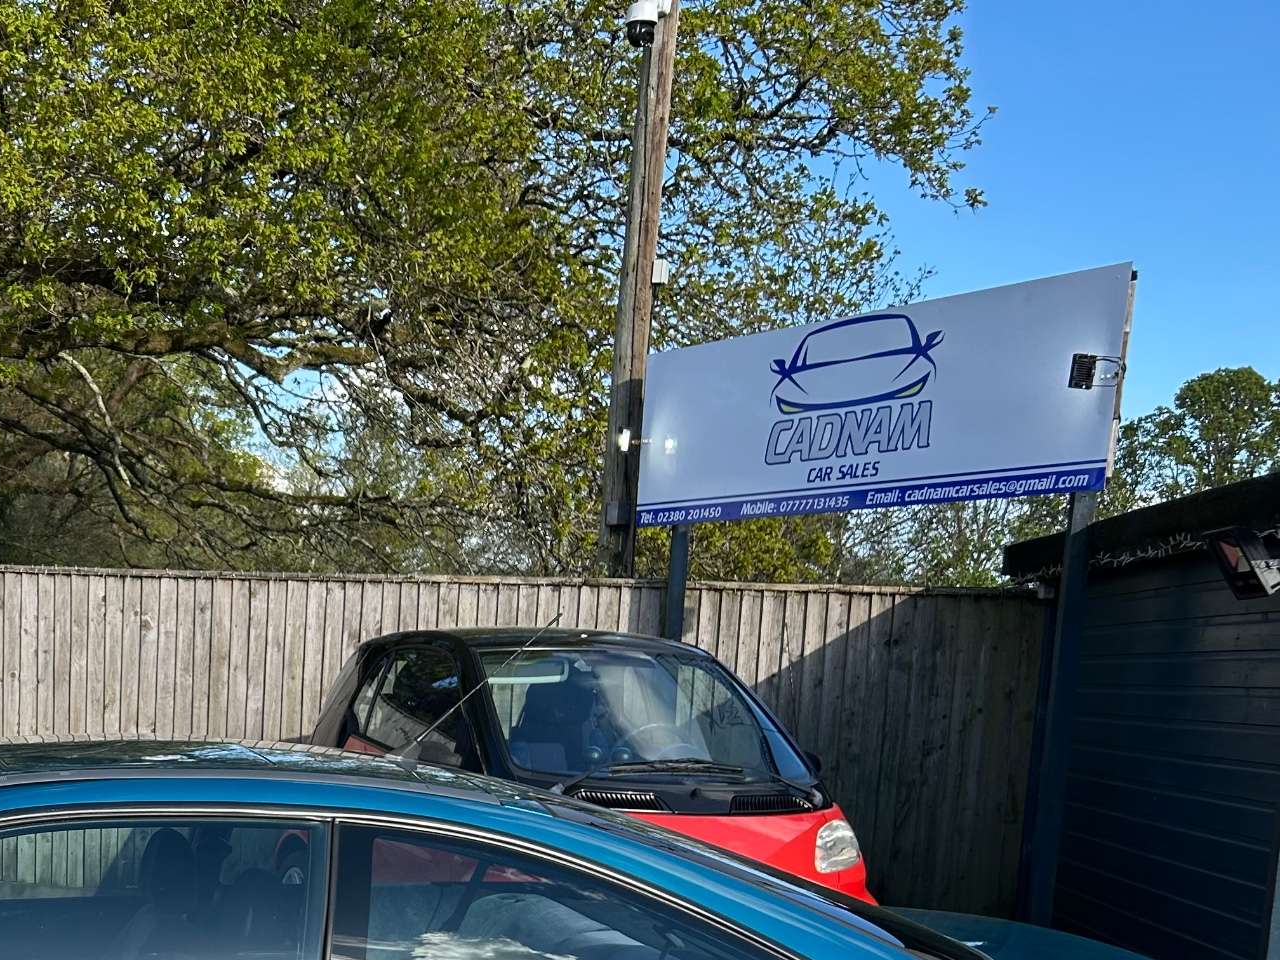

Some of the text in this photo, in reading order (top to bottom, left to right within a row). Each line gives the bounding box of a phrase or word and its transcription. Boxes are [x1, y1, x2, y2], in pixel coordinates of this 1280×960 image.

[765, 400, 933, 465] CADNAM
[807, 461, 881, 483] CAR SALES
[640, 473, 1090, 524] Tel: 02380 201450 Mobile: 07777131435 Email: cadnamcarsales@gmail.com
